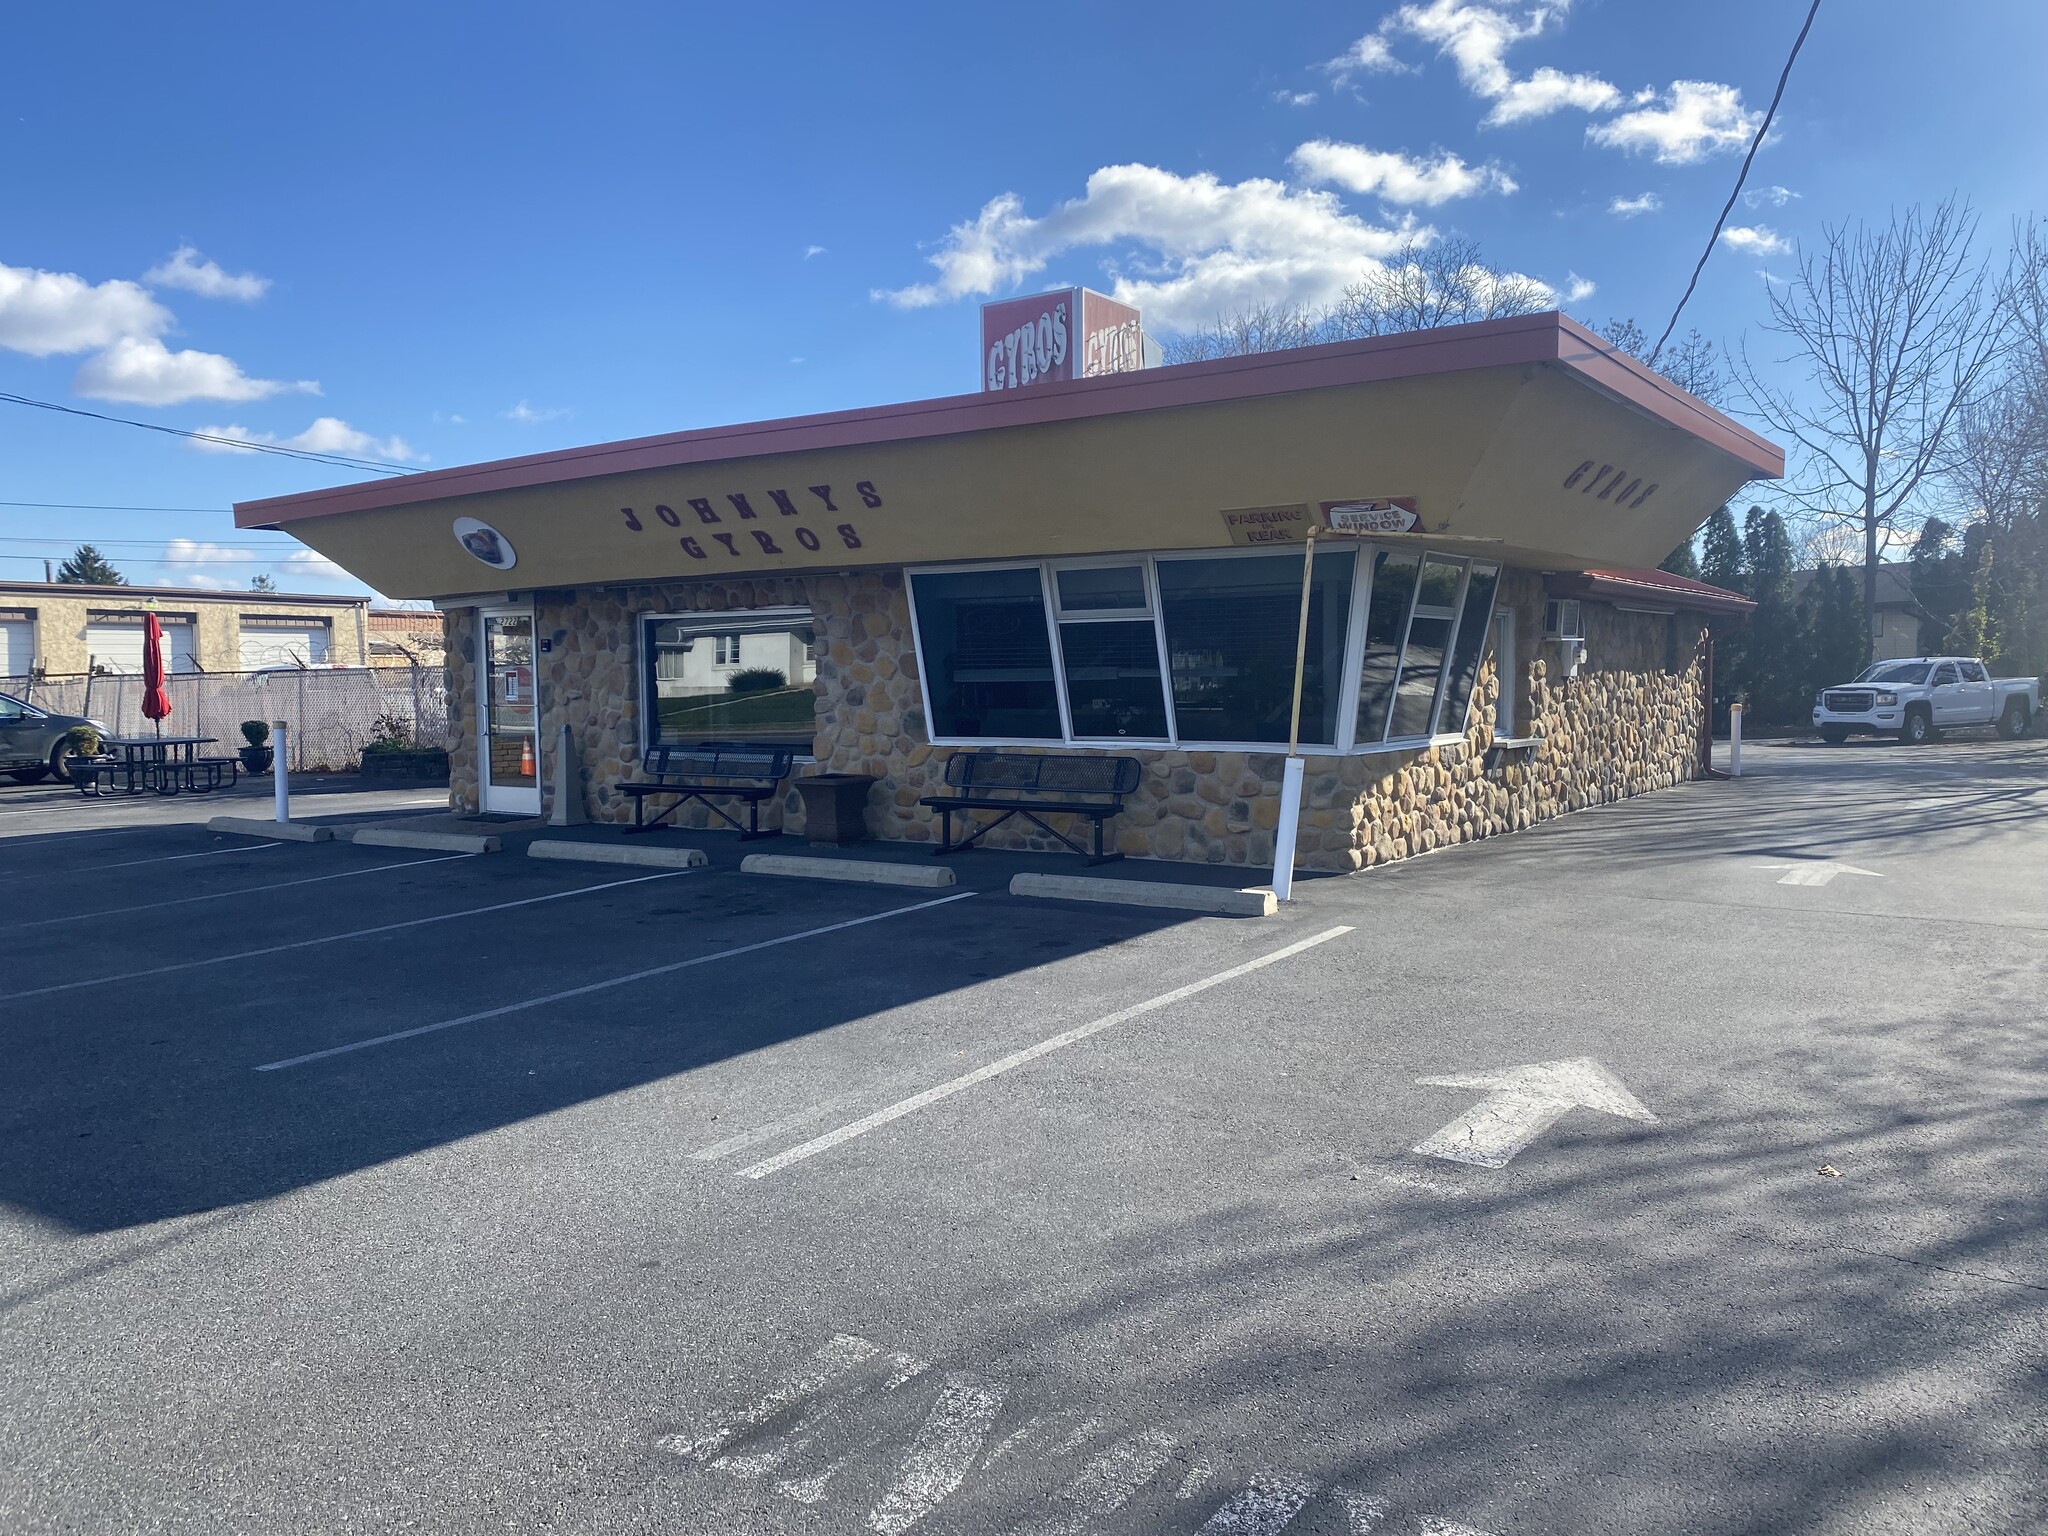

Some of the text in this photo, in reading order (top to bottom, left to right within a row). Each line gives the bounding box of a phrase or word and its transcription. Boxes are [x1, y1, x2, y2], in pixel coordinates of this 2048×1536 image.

[988, 302, 1067, 391] GYROS
[1563, 460, 1660, 509] GYROS
[620, 480, 882, 532] JOHNNYS
[1228, 511, 1302, 525] PARKING
[1340, 510, 1401, 523] SERVICE
[1247, 528, 1293, 542] REAR
[1337, 519, 1406, 531] WINDOW
[680, 523, 862, 559] GYROS
